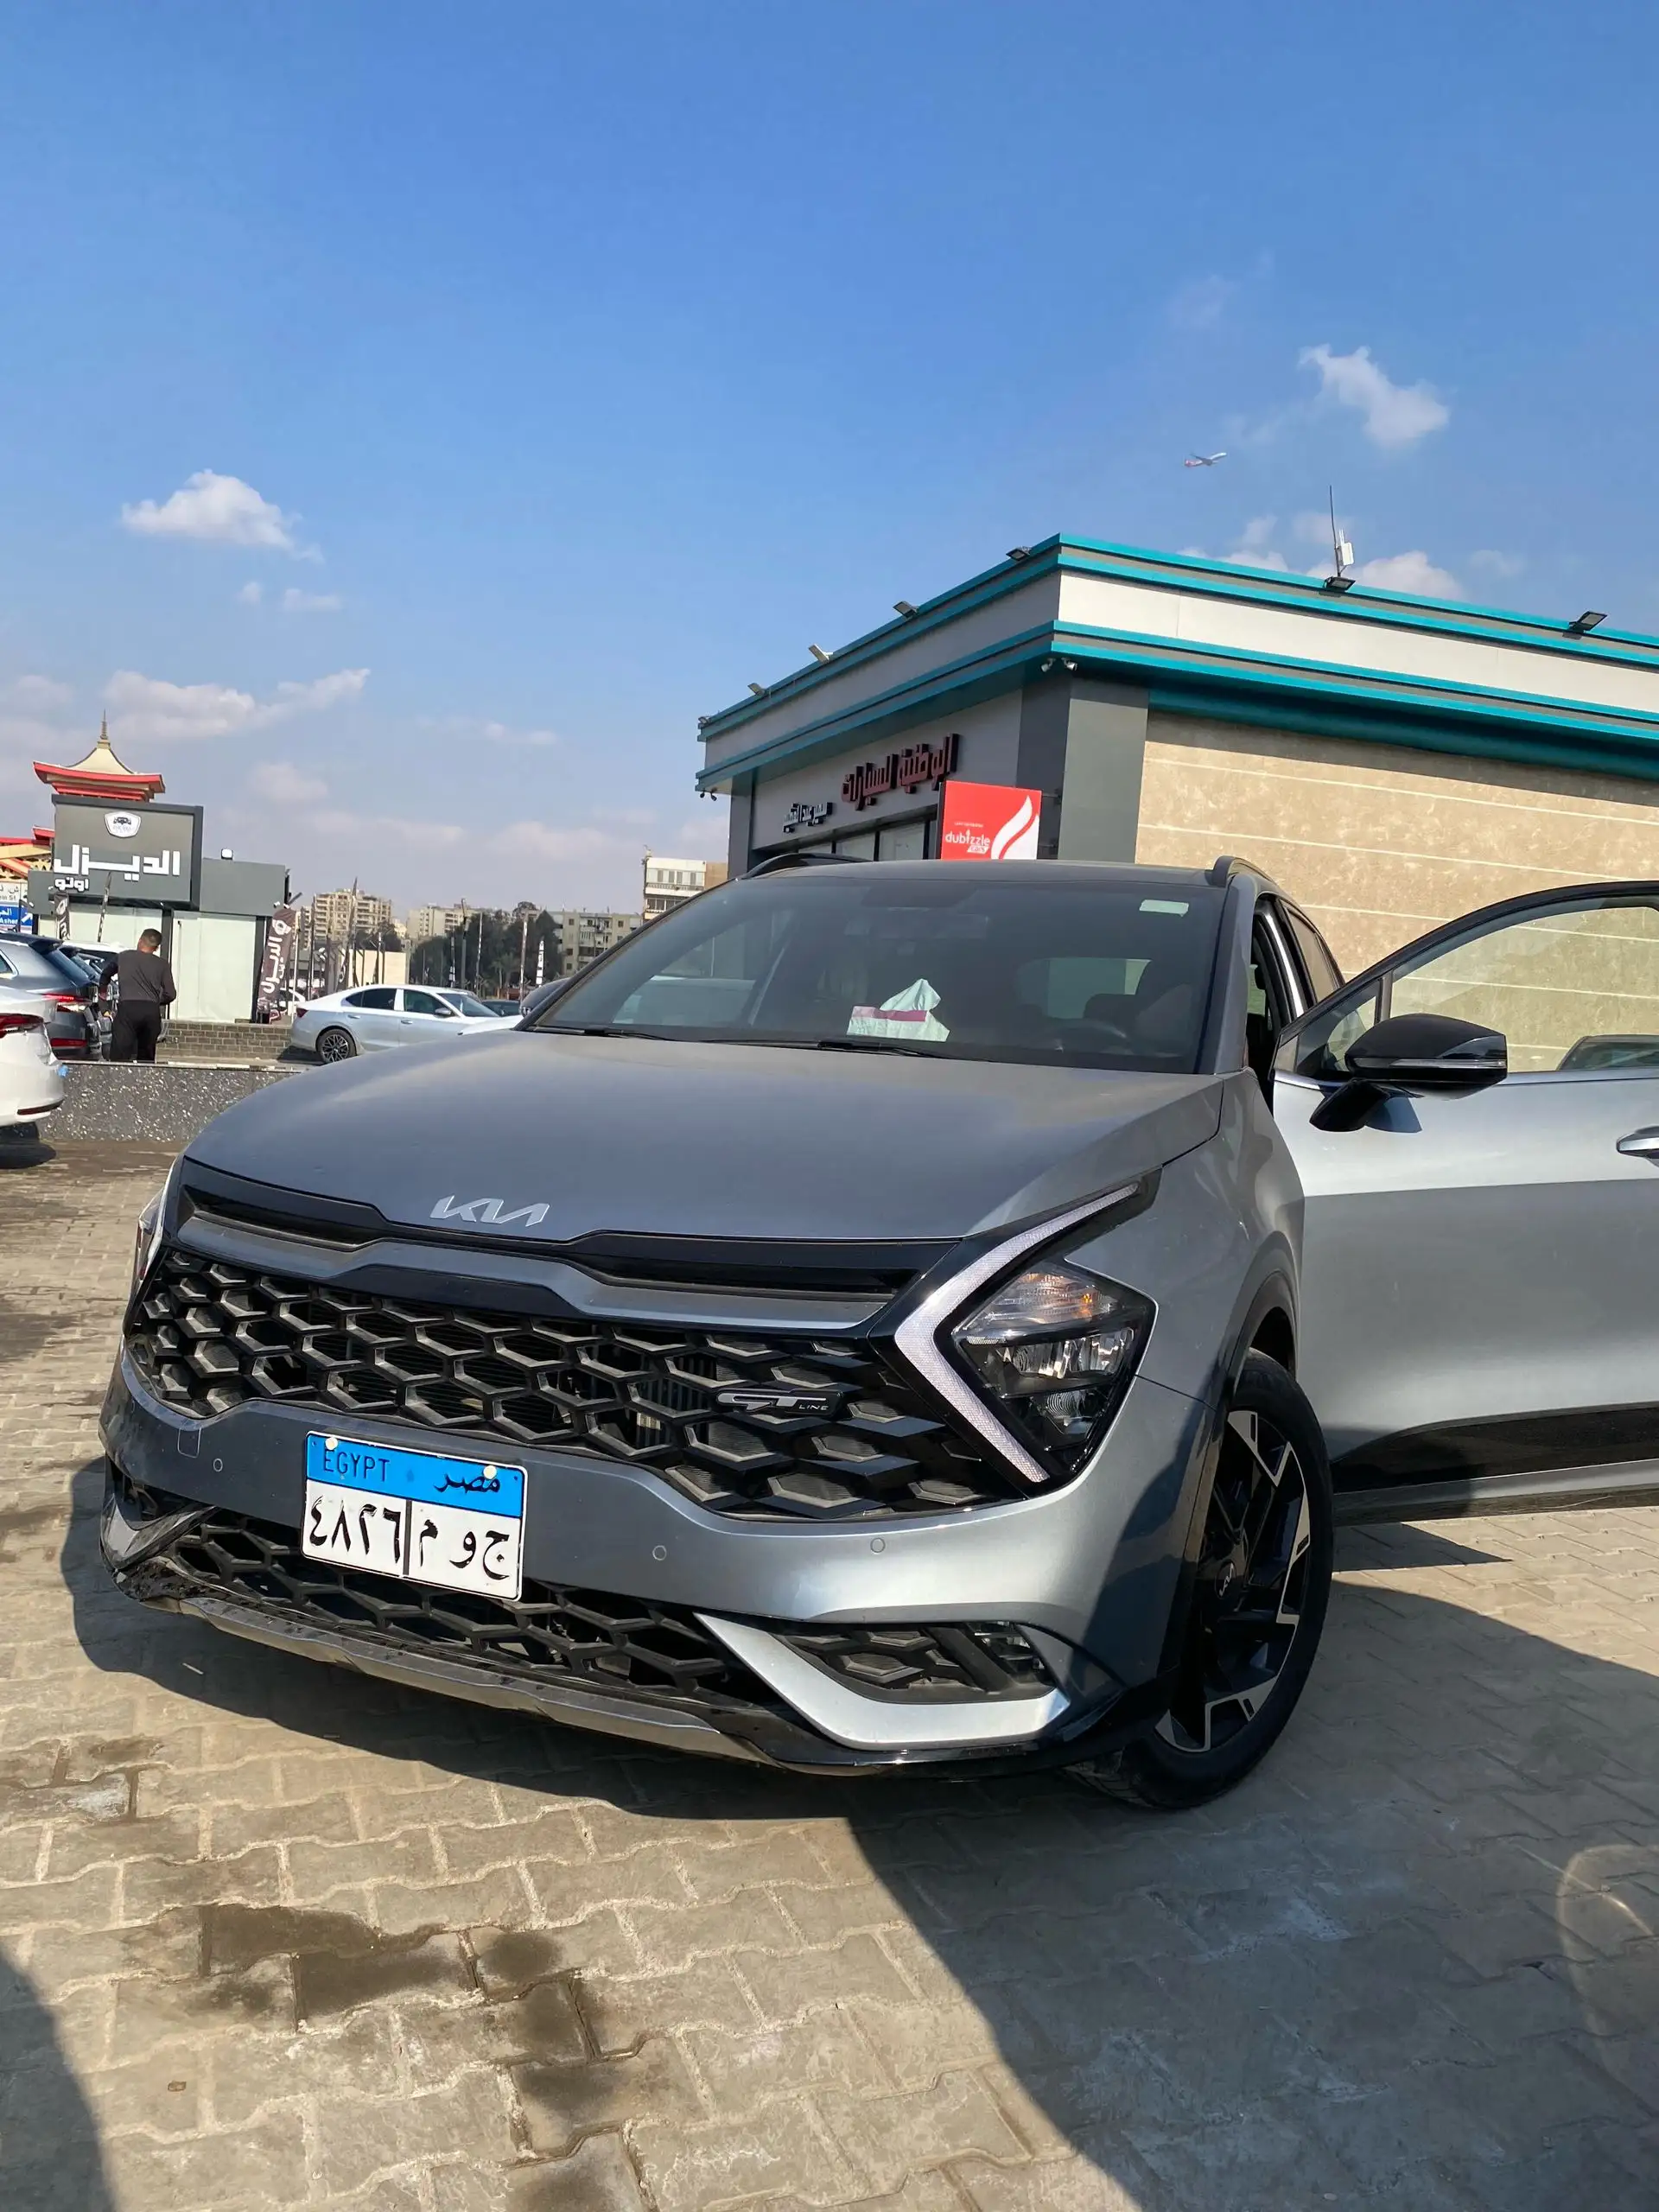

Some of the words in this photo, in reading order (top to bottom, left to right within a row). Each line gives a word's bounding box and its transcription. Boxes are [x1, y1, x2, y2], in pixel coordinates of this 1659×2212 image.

[945, 830, 990, 846] dubizzle
[54, 844, 181, 881] الديزل
[323, 1448, 391, 1483] EGYPT
[434, 1473, 501, 1494] مصر
